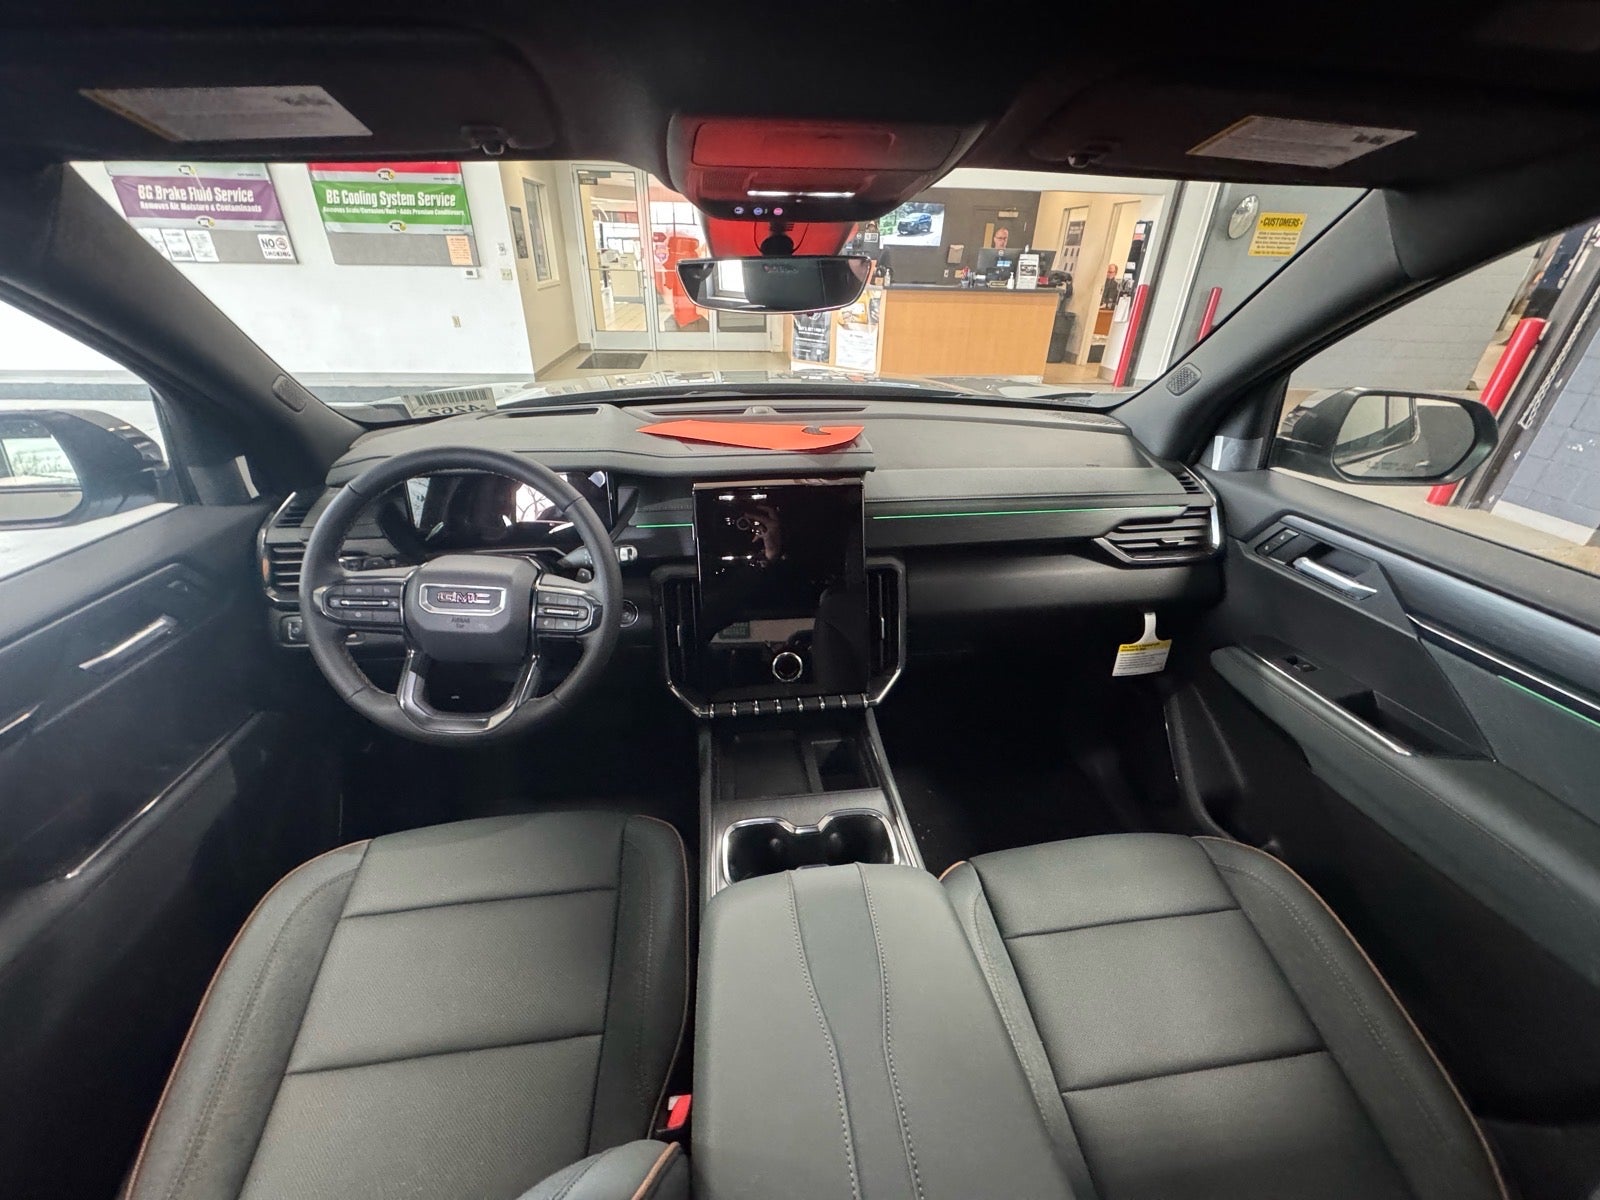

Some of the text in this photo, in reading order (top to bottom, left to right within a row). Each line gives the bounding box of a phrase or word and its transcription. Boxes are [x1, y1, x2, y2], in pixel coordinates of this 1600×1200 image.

[138, 184, 254, 203] BG Brake Fluid Service
[326, 189, 455, 208] BG Cooling System Service
[180, 203, 209, 212] Moisture
[216, 203, 262, 213] Contaminants
[1263, 217, 1301, 227] CUSTOMERS
[261, 238, 275, 248] NO
[264, 249, 291, 257] SMOKING
[437, 591, 491, 604] GMC
